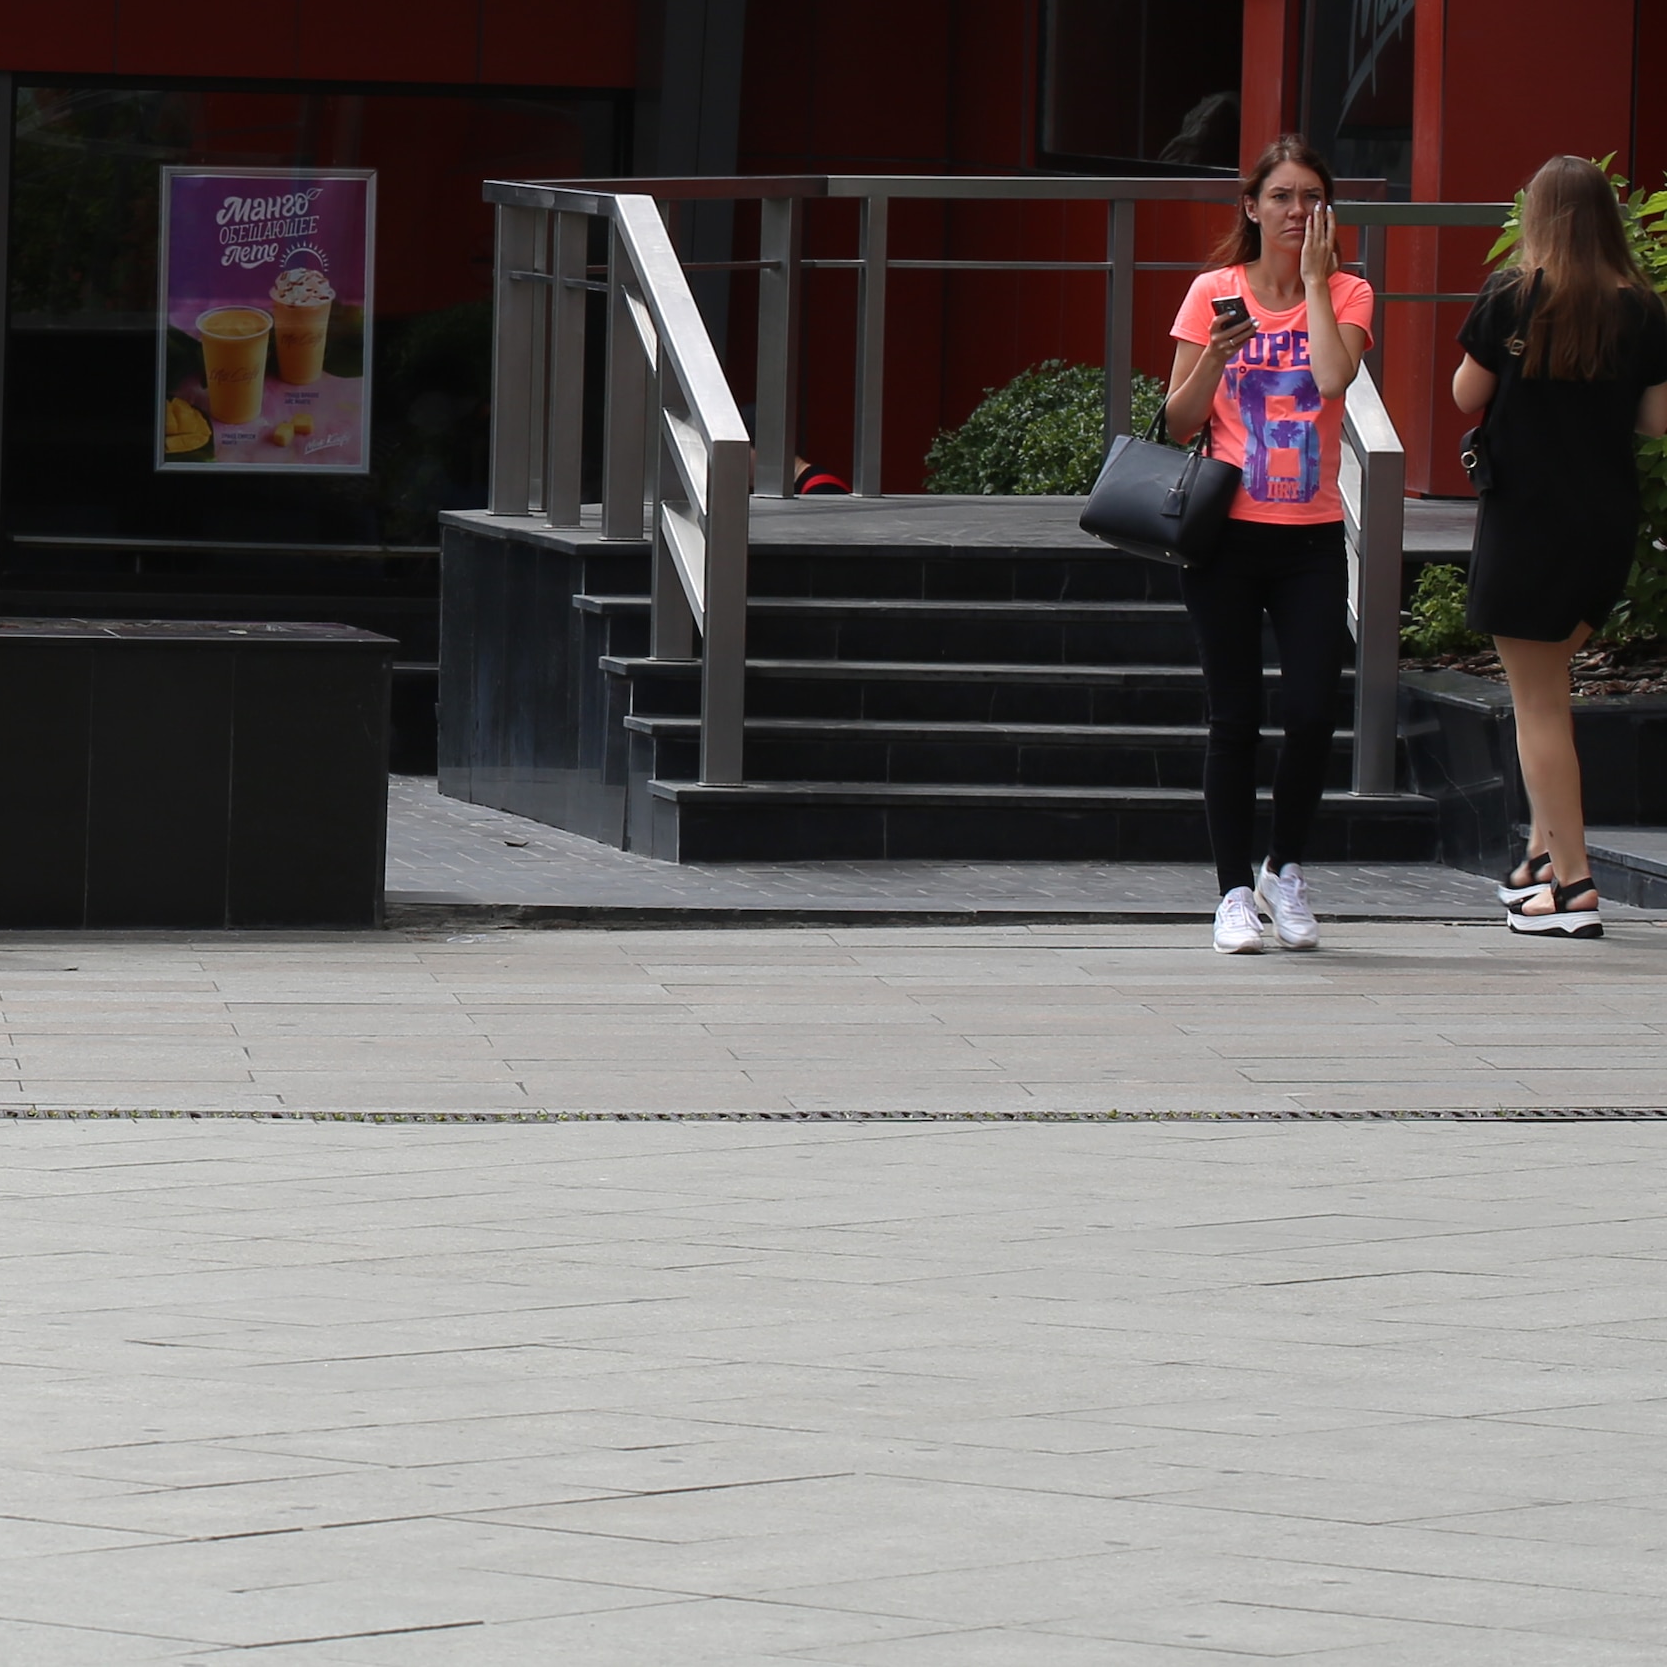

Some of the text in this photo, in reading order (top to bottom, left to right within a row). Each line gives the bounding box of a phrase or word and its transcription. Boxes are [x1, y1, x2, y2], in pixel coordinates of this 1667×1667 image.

[219, 215, 320, 245] ОБЕЩАЮЩЕЕ
[1226, 329, 1311, 367] UPE
[1238, 369, 1323, 504] 6
